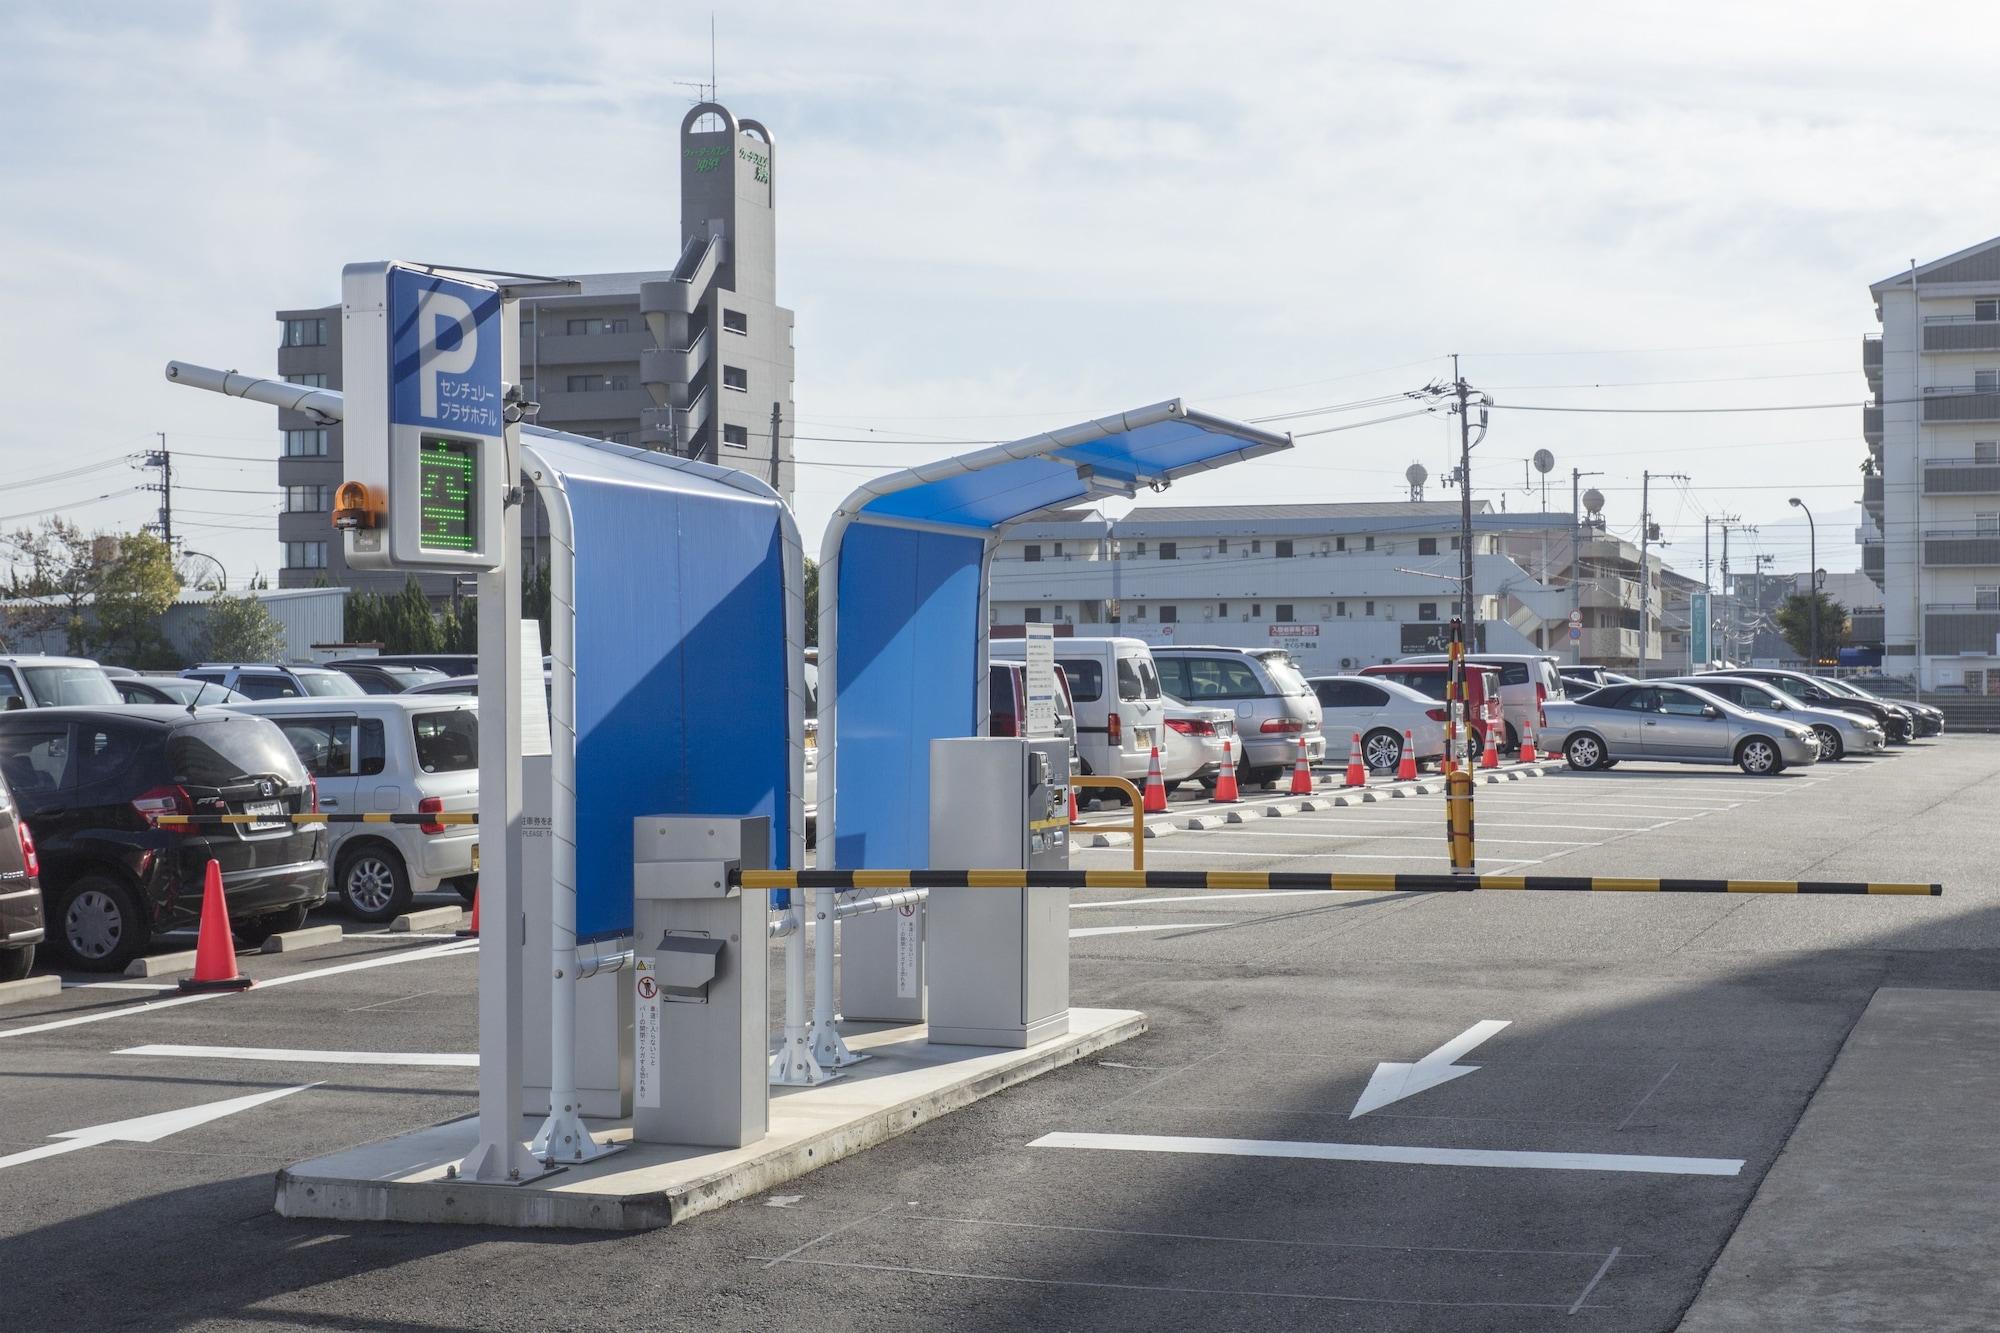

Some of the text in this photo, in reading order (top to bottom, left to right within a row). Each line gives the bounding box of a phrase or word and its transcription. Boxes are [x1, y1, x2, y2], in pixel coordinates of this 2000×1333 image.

[417, 288, 478, 419] P
[440, 378, 495, 403] センチュリー
[440, 402, 498, 427] プラザホテル
[420, 441, 472, 547] 空
[522, 830, 543, 838] PLEASE
[649, 1005, 657, 1066] 車道に入らないこと
